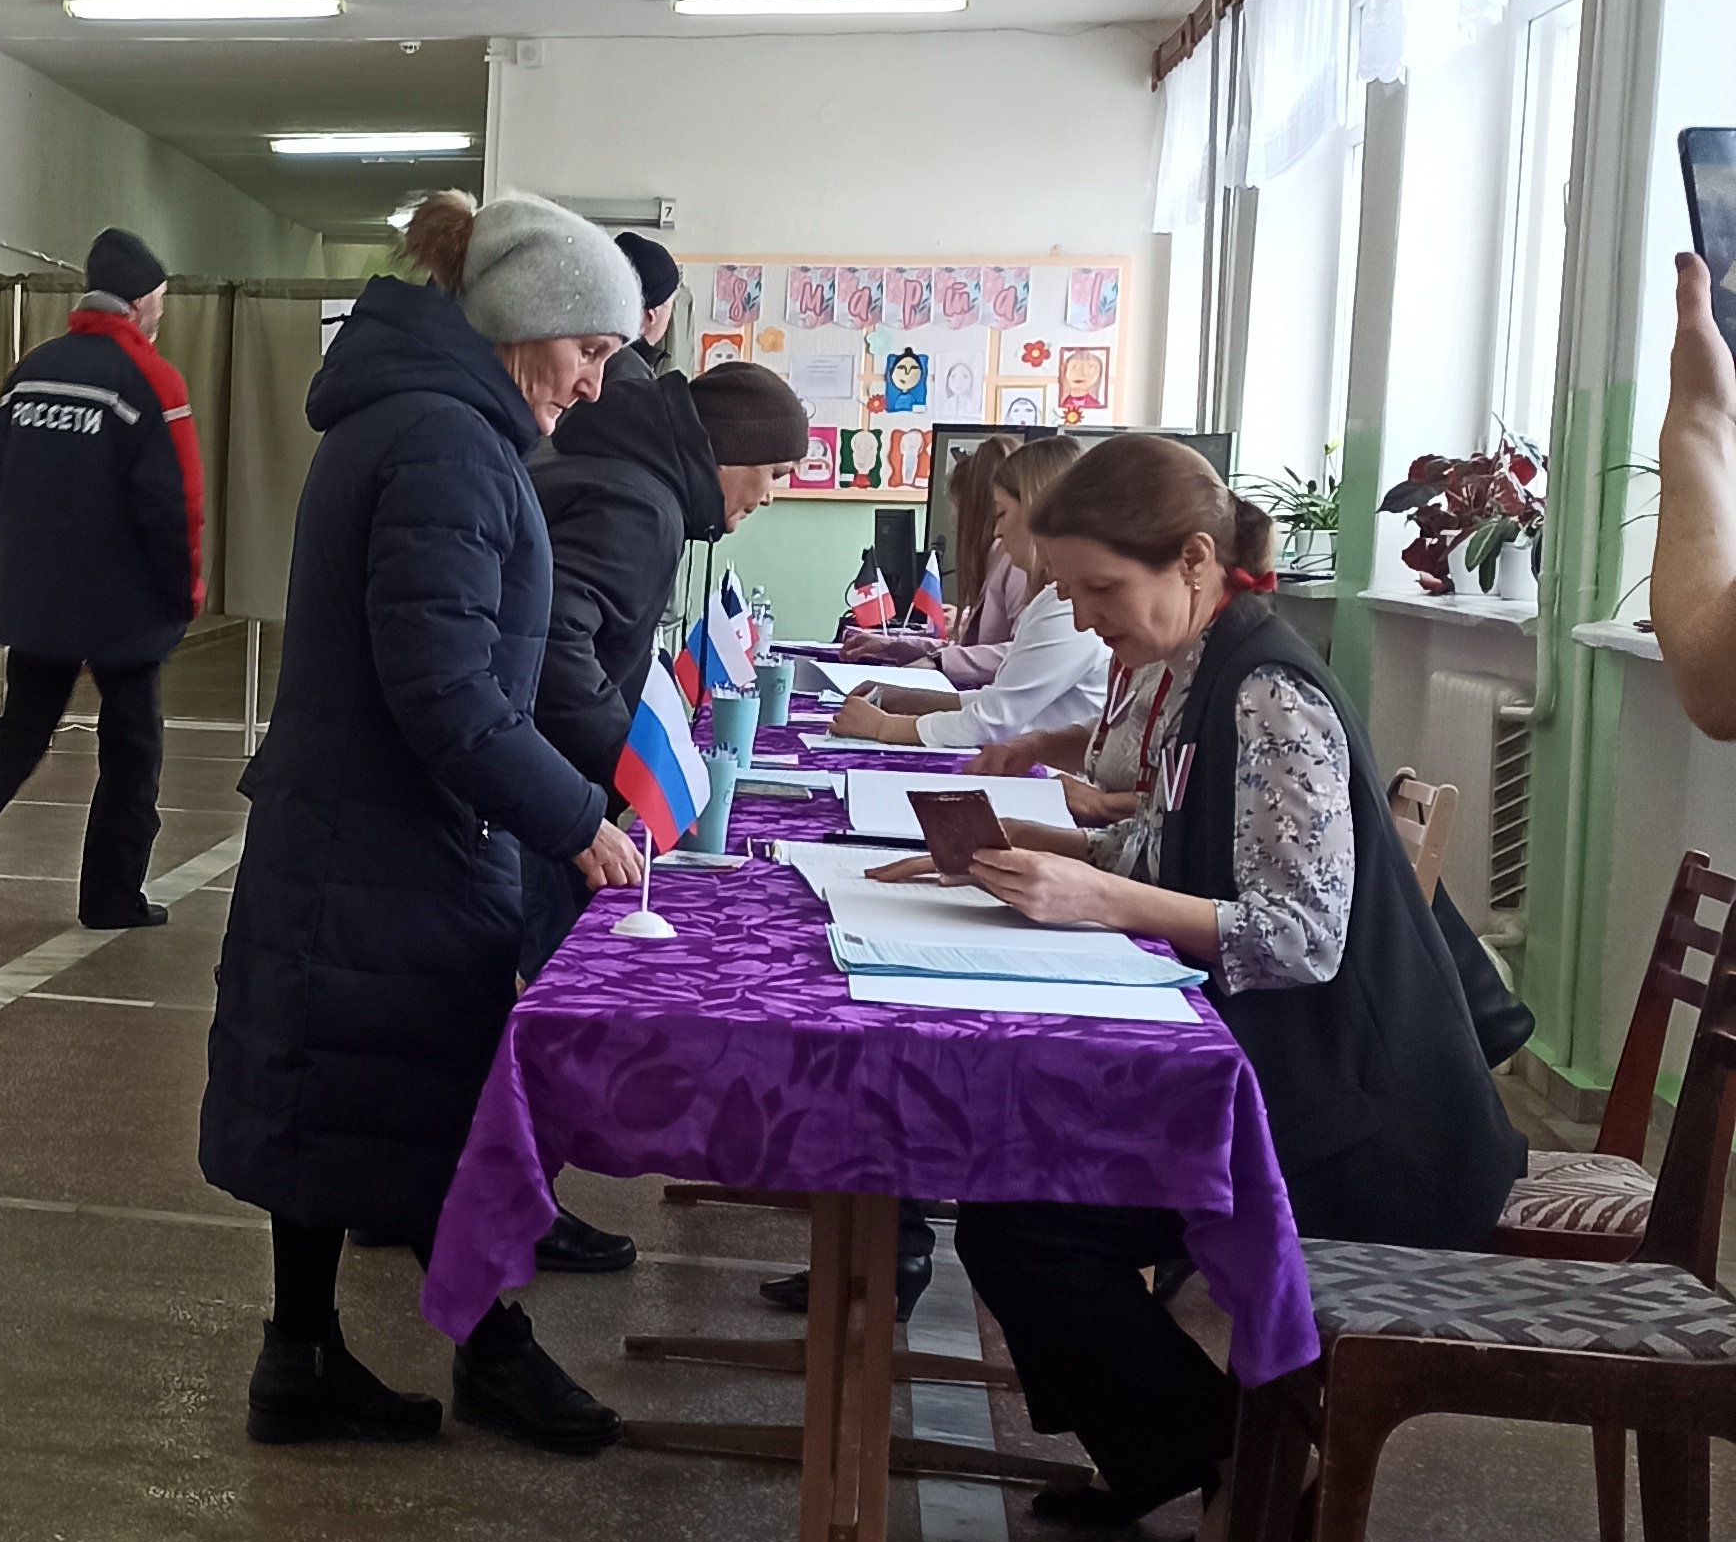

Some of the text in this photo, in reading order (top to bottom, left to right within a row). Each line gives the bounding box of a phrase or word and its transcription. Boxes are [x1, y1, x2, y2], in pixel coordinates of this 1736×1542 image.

[664, 206, 673, 218] 7
[729, 278, 747, 322] 8
[11, 401, 103, 434] РОССЕТИ
